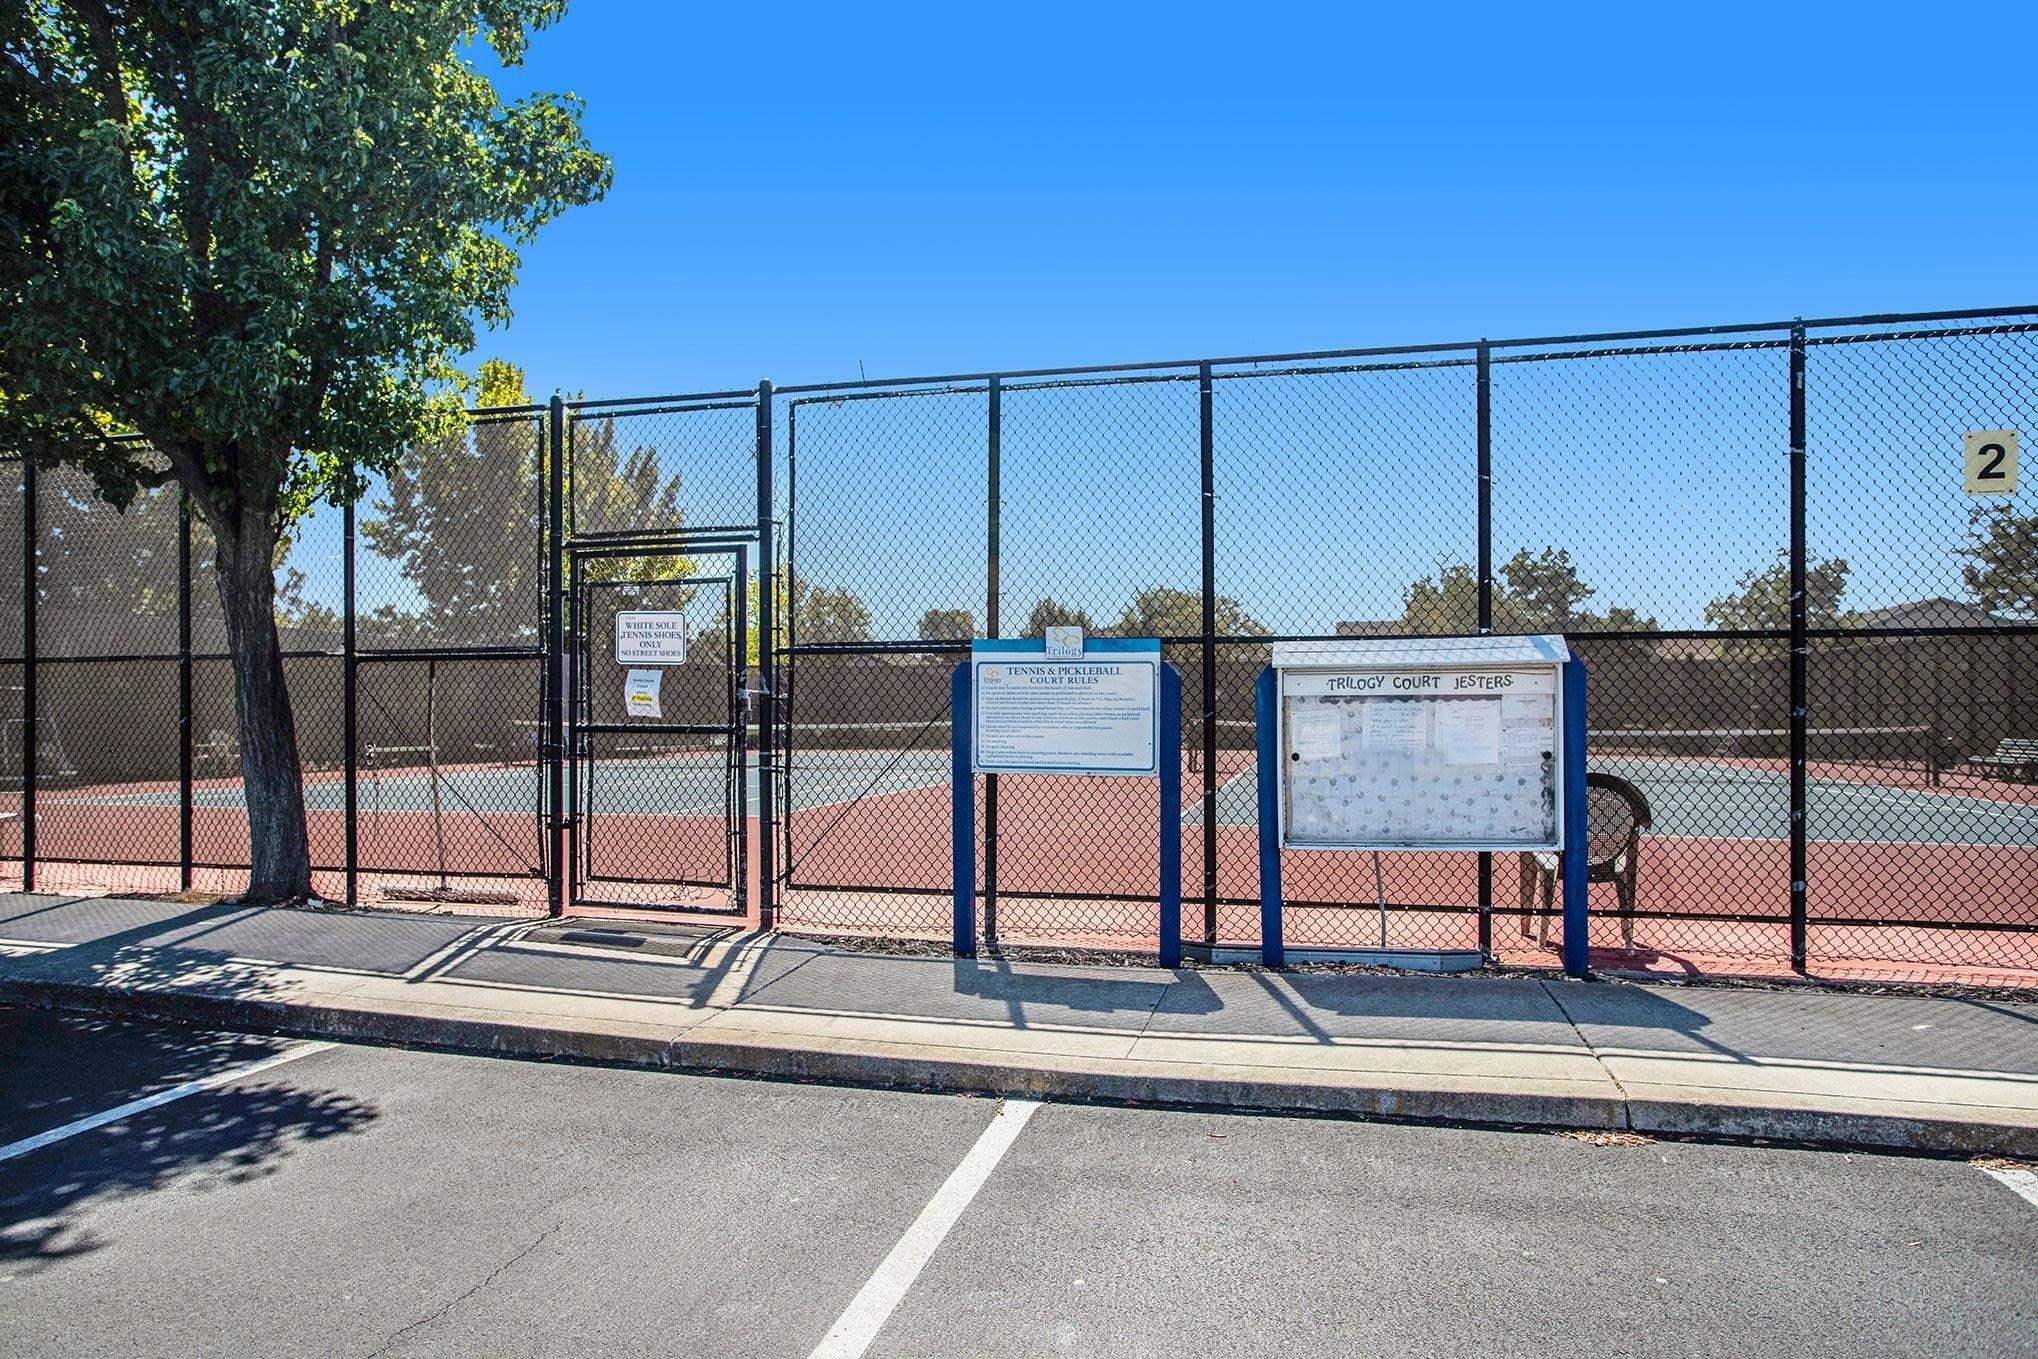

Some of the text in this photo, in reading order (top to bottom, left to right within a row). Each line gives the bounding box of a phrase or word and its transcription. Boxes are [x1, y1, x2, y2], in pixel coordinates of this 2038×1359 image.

[1977, 443, 2006, 480] 2
[624, 621, 678, 630] WHITE SOLE
[621, 631, 681, 639] TENNIS SHOES
[639, 640, 662, 649] ONLY
[621, 649, 681, 657] NO STREET SHOES
[1046, 646, 1083, 657] Trilogy
[1006, 666, 1123, 676] TENNIS & PICKLEBALL
[1029, 676, 1099, 685] COURT RULES
[1328, 674, 1512, 691] TRILOGY COURT JESTERS
